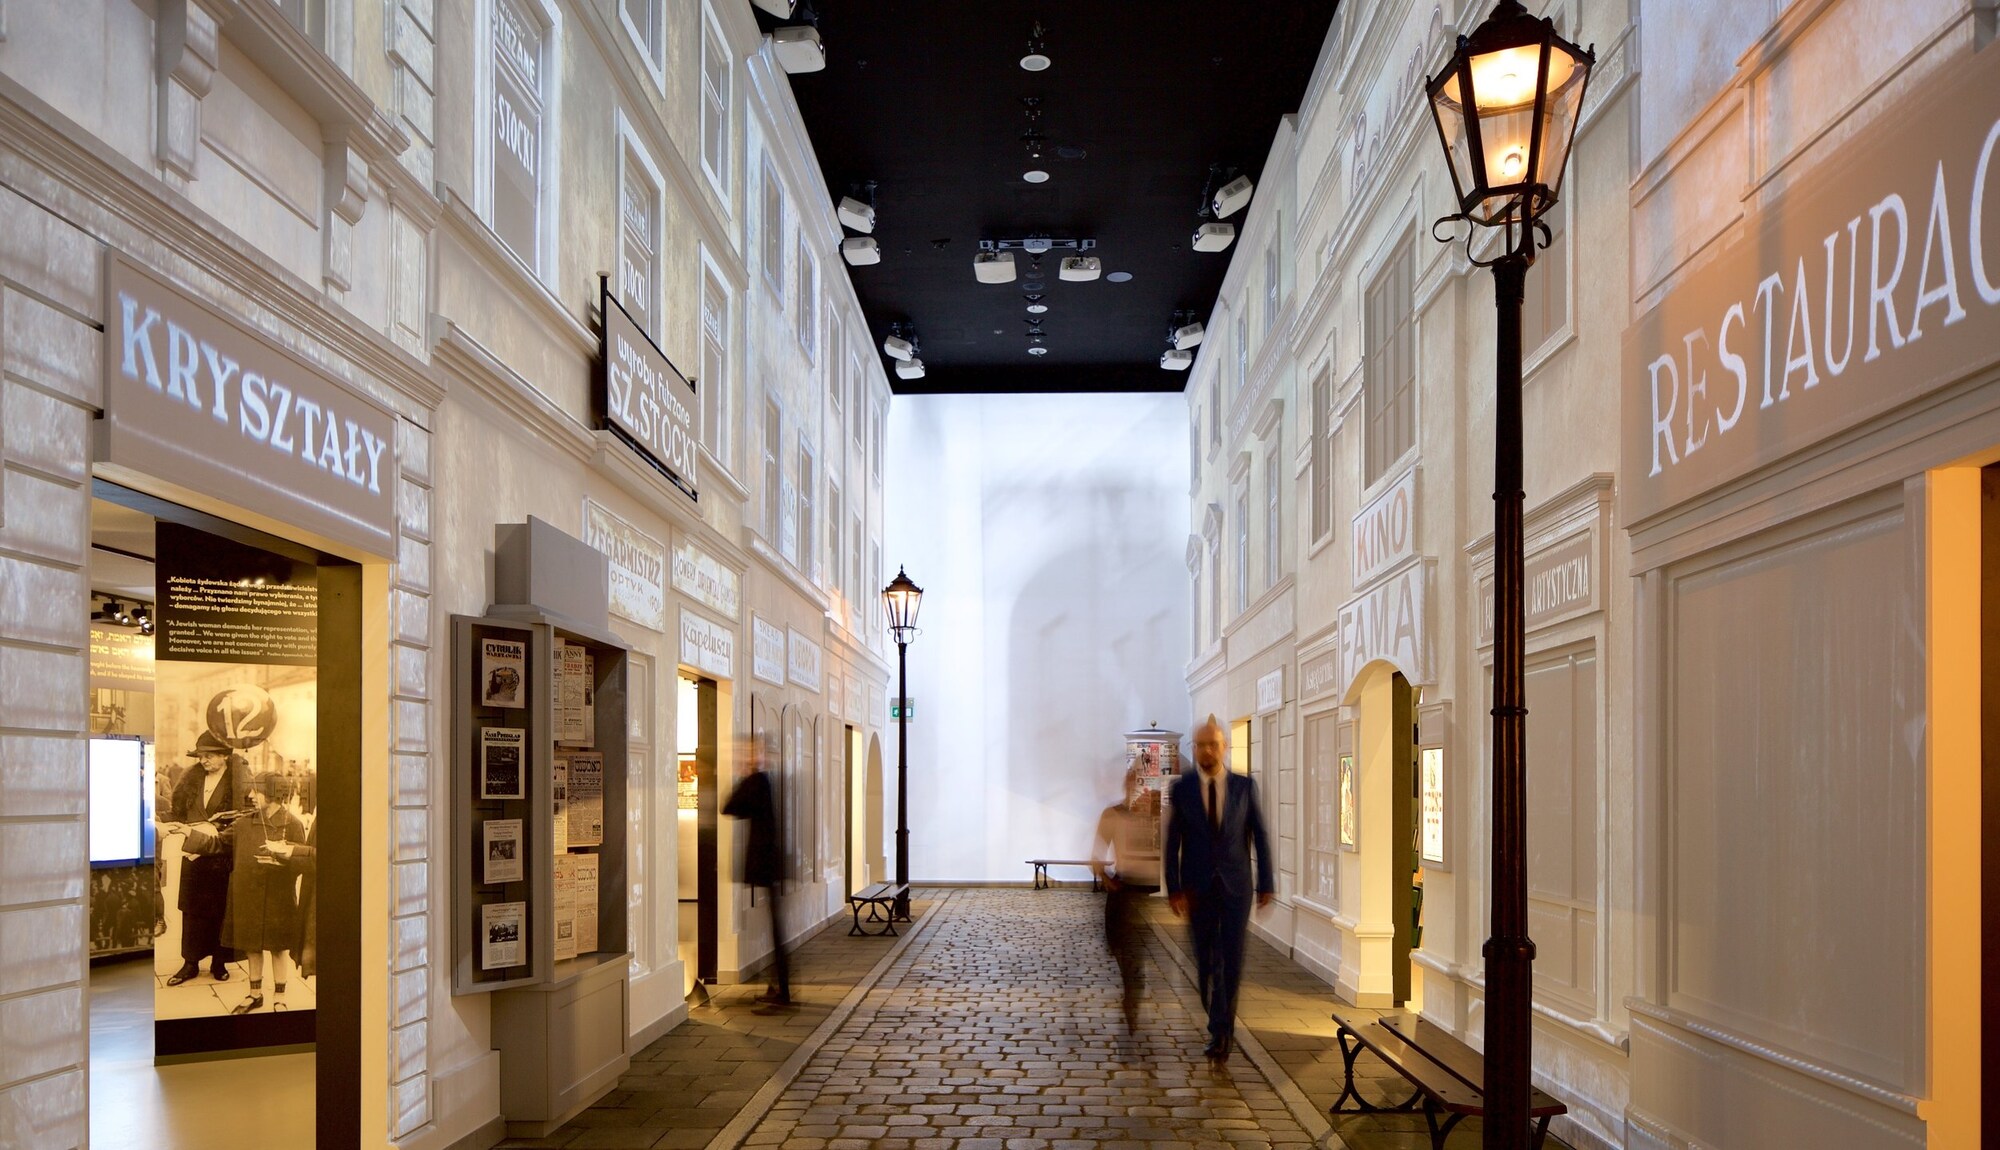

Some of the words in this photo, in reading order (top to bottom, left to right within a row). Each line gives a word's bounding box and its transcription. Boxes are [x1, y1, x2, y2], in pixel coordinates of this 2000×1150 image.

[498, 93, 535, 177] STOCKI
[119, 290, 387, 496] KRYSZTAŁY
[617, 333, 655, 396] wyroby
[657, 371, 691, 430] futrzane
[1356, 486, 1409, 578] KINO
[174, 602, 210, 611] domagamy
[239, 606, 282, 616] decydującego
[199, 586, 233, 595] Przyznano
[217, 596, 252, 605] twierdzimy
[1531, 554, 1590, 615] ARTYSTYCZNA
[169, 637, 202, 645] Moreover,
[236, 640, 269, 648] concerned
[169, 645, 196, 653] decisive
[1340, 573, 1419, 693] FAMA
[217, 694, 264, 740] 12
